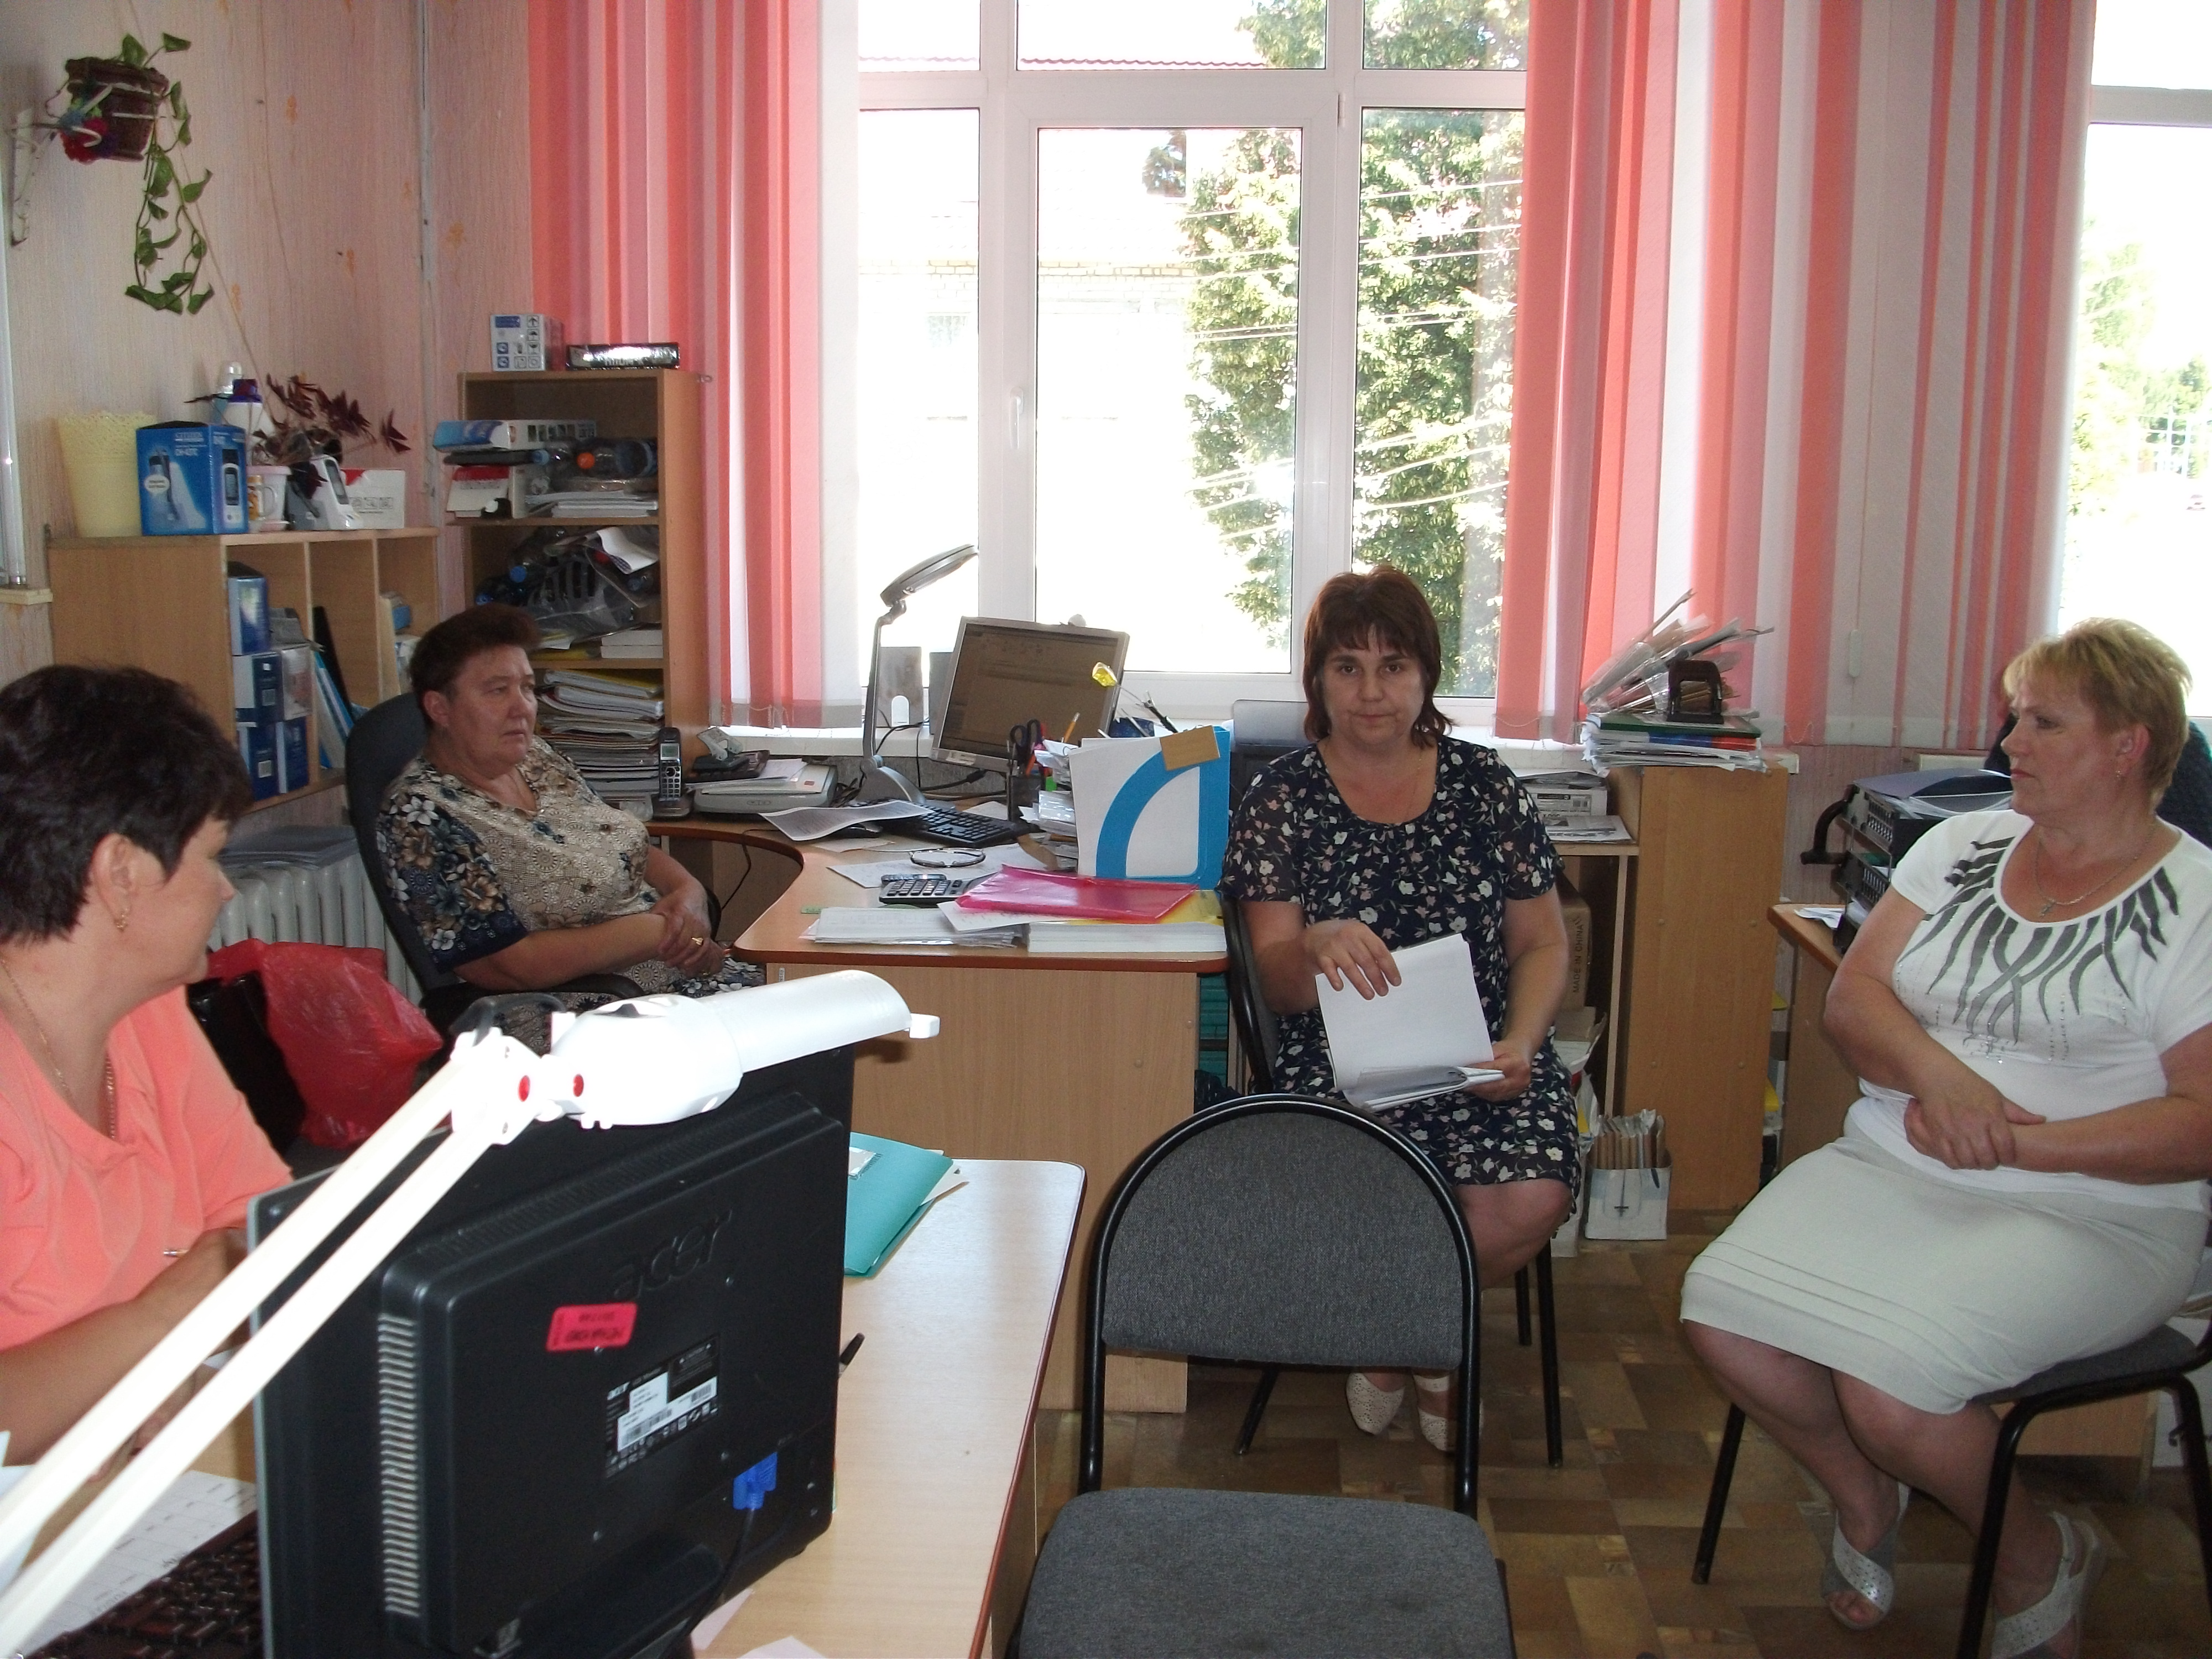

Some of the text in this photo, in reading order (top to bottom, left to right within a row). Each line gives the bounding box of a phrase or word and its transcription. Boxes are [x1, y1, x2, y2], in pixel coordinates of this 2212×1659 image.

[1573, 924, 1584, 993] MADE IN CHINA
[612, 1210, 733, 1298] acer
